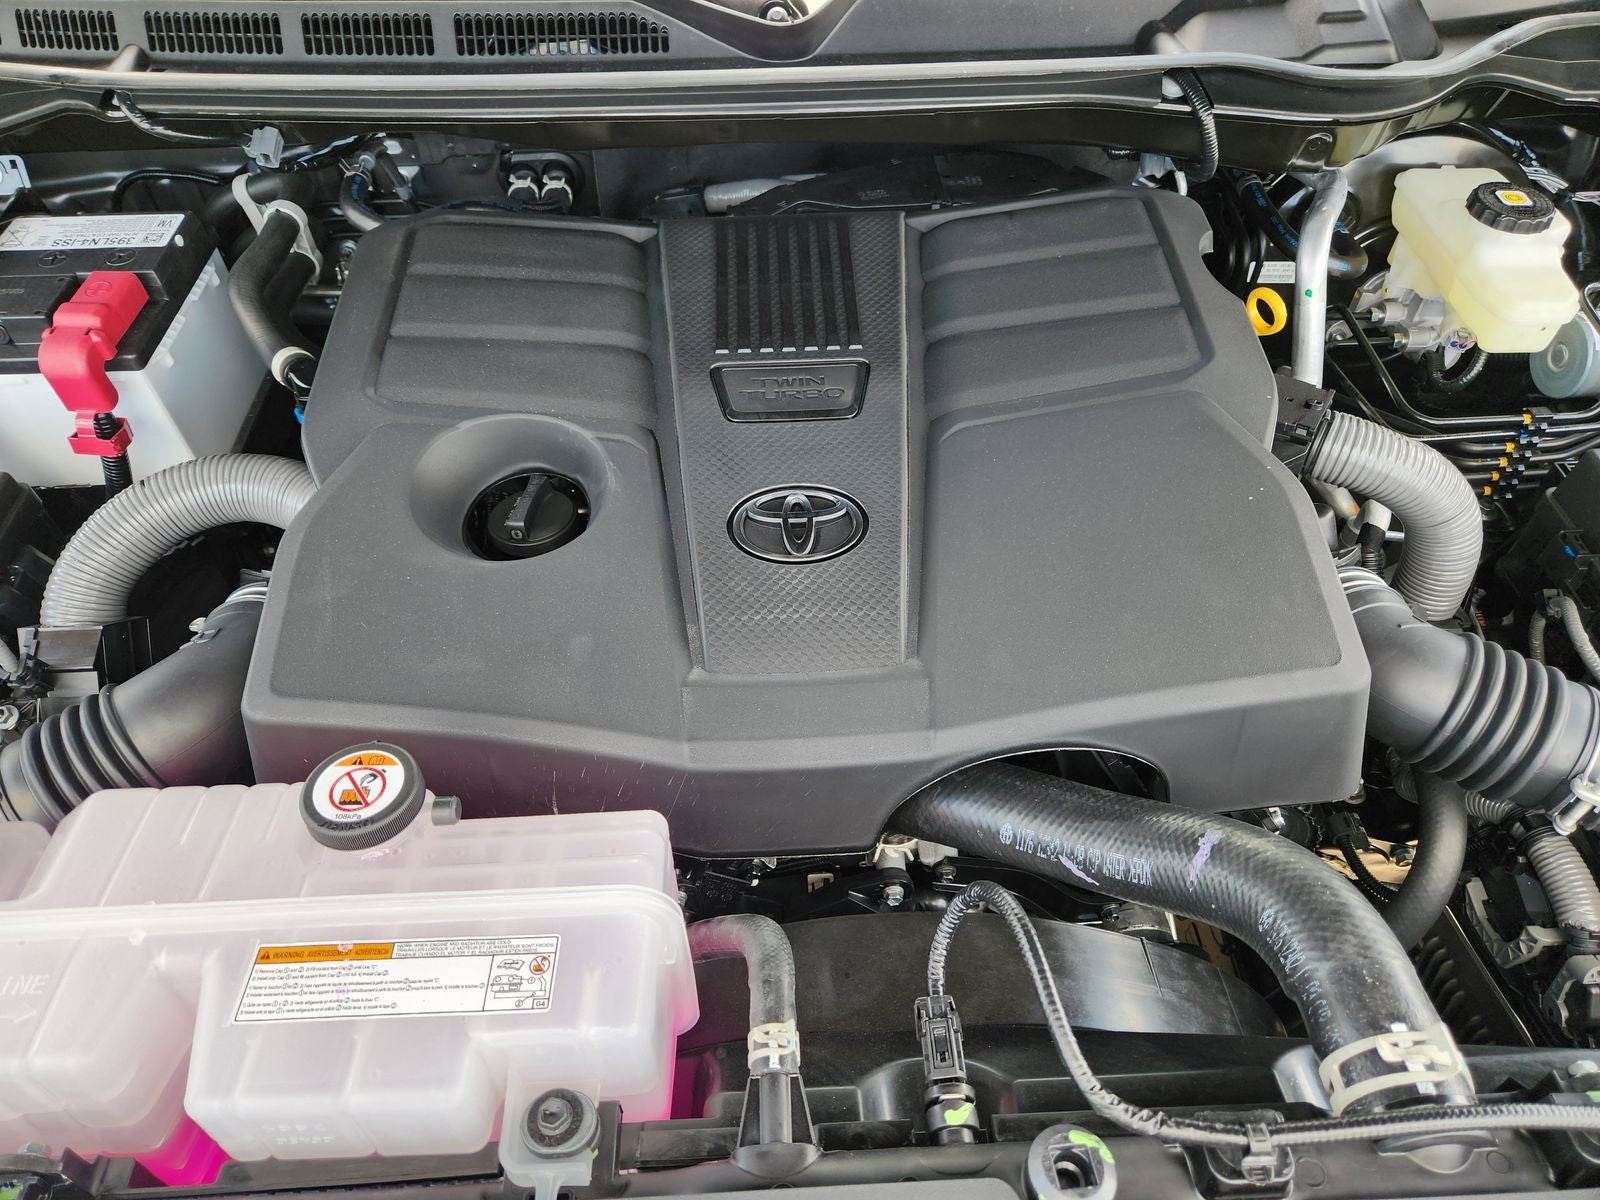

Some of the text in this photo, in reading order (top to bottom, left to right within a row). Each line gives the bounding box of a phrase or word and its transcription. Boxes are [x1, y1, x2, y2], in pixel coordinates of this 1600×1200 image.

[157, 218, 172, 228] VM
[51, 236, 135, 247] 395LN4-ISS
[751, 375, 825, 388] TWIN
[738, 386, 845, 399] TURBO
[272, 951, 305, 959] WARNING
[0, 975, 49, 996] INE
